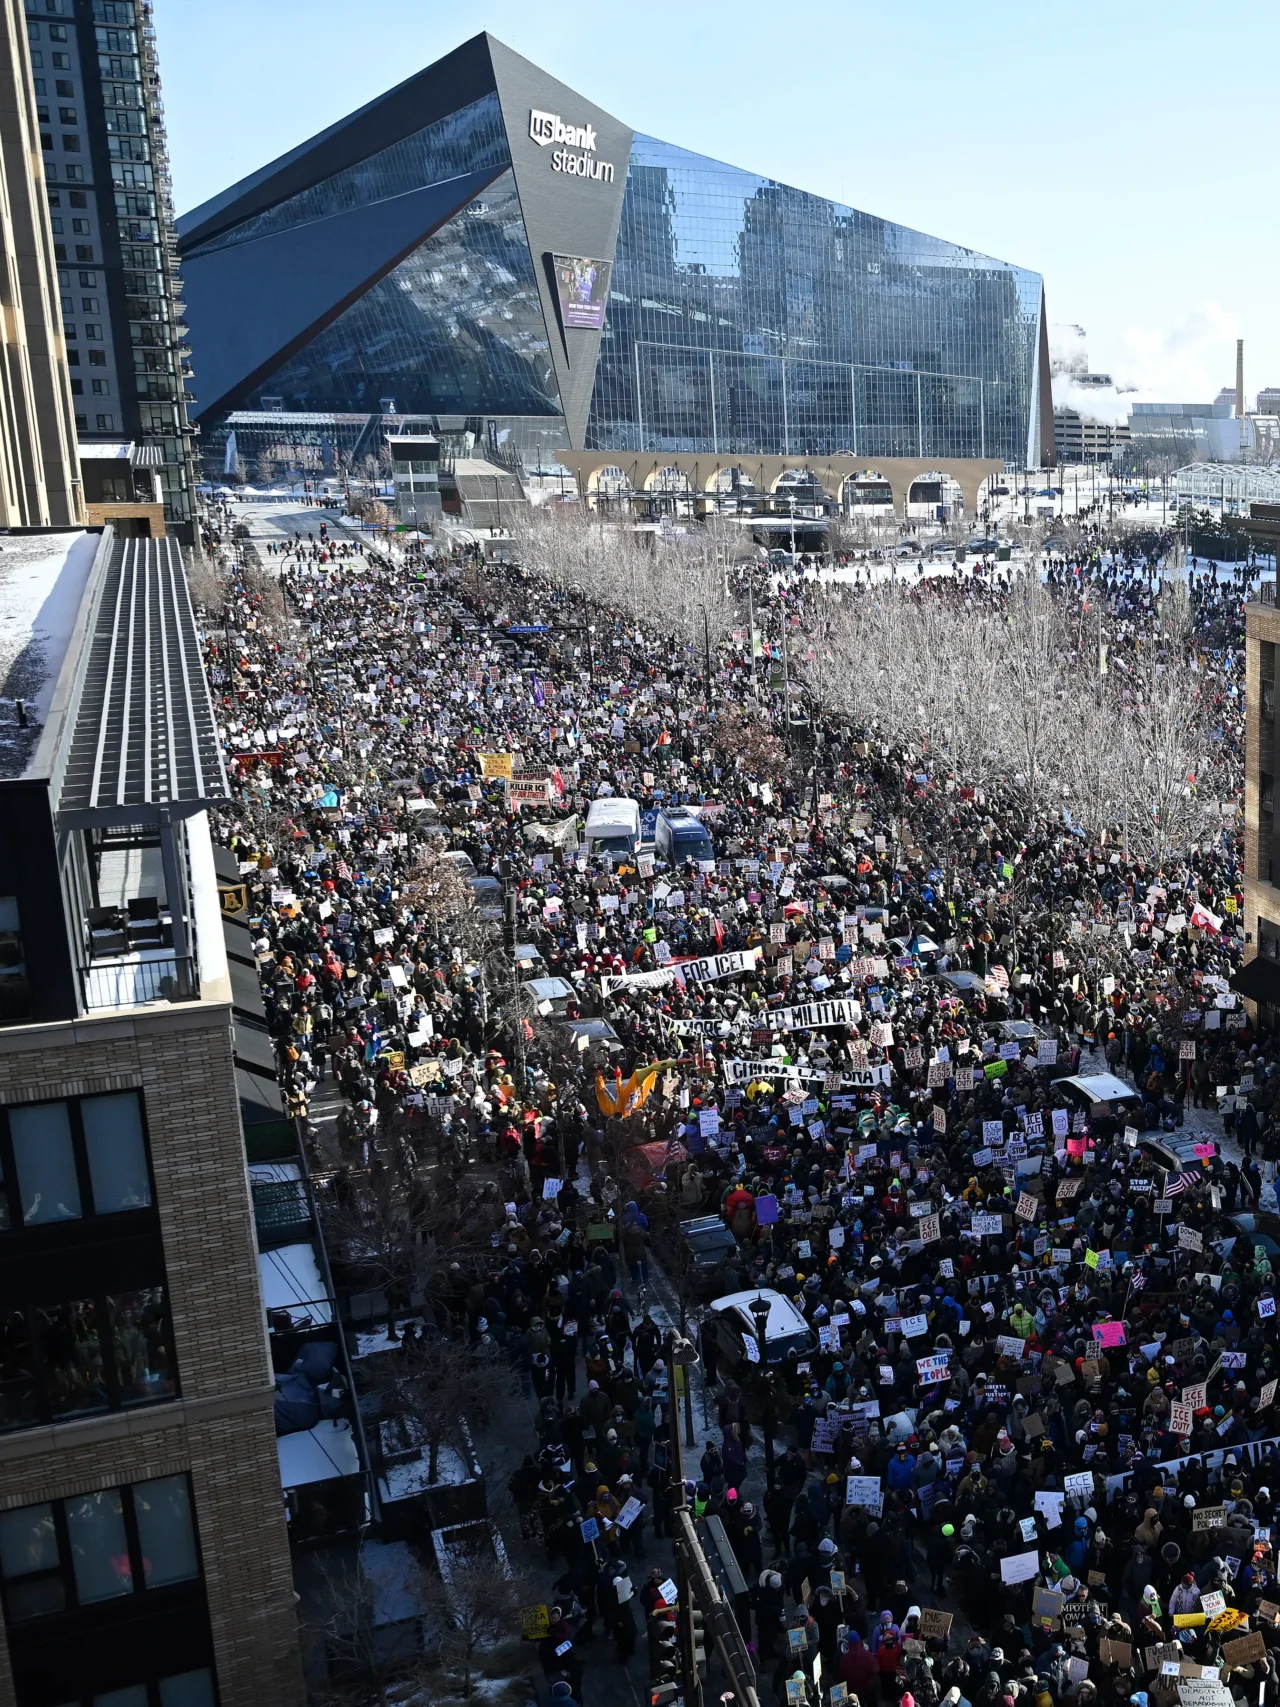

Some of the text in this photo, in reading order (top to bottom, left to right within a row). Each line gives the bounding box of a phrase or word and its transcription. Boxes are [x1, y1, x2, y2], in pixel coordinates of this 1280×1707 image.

[551, 148, 614, 183] stadium
[510, 783, 546, 792] KILLER ICE
[681, 962, 711, 982] FOR
[715, 953, 745, 976] ICE!
[792, 1002, 853, 1028] MILITIA!
[871, 1029, 884, 1040] ICE
[906, 1050, 919, 1059] ICE
[417, 1067, 431, 1076] ICE
[798, 1068, 820, 1078] LA
[957, 1071, 971, 1080] ICE
[415, 1074, 426, 1083] OUT
[826, 1076, 839, 1084] ICE
[957, 1079, 972, 1087] OUT!
[431, 1097, 452, 1106] ICE
[431, 1106, 452, 1115] OUT
[935, 1111, 944, 1121] ICE
[1026, 1113, 1041, 1126] ICE
[1026, 1125, 1042, 1136] OUT
[1012, 1133, 1022, 1141] ICE
[993, 1149, 1007, 1157] STOP
[1012, 1146, 1027, 1154] STOP
[1058, 1189, 1075, 1197] OUT!
[1020, 1197, 1036, 1210] ICE
[1018, 1205, 1034, 1217] OUT!
[922, 1220, 937, 1231] ICE
[922, 1229, 939, 1240] OUT!
[1180, 1227, 1197, 1238] DOWN
[905, 1316, 923, 1326] ICE
[1178, 1340, 1194, 1348] ICE
[918, 1356, 949, 1370] WE THE
[1184, 1391, 1203, 1401] ICE
[1173, 1409, 1189, 1421] ICE
[1172, 1421, 1190, 1433] OUT!
[1066, 1474, 1090, 1487] ICE
[1193, 1509, 1226, 1520] NO SECRET
[1206, 1600, 1221, 1609] YOUR
[924, 1612, 942, 1623] DUE
[1210, 1611, 1233, 1628] LOVE
[1181, 1687, 1226, 1695] DEMOCRACY
